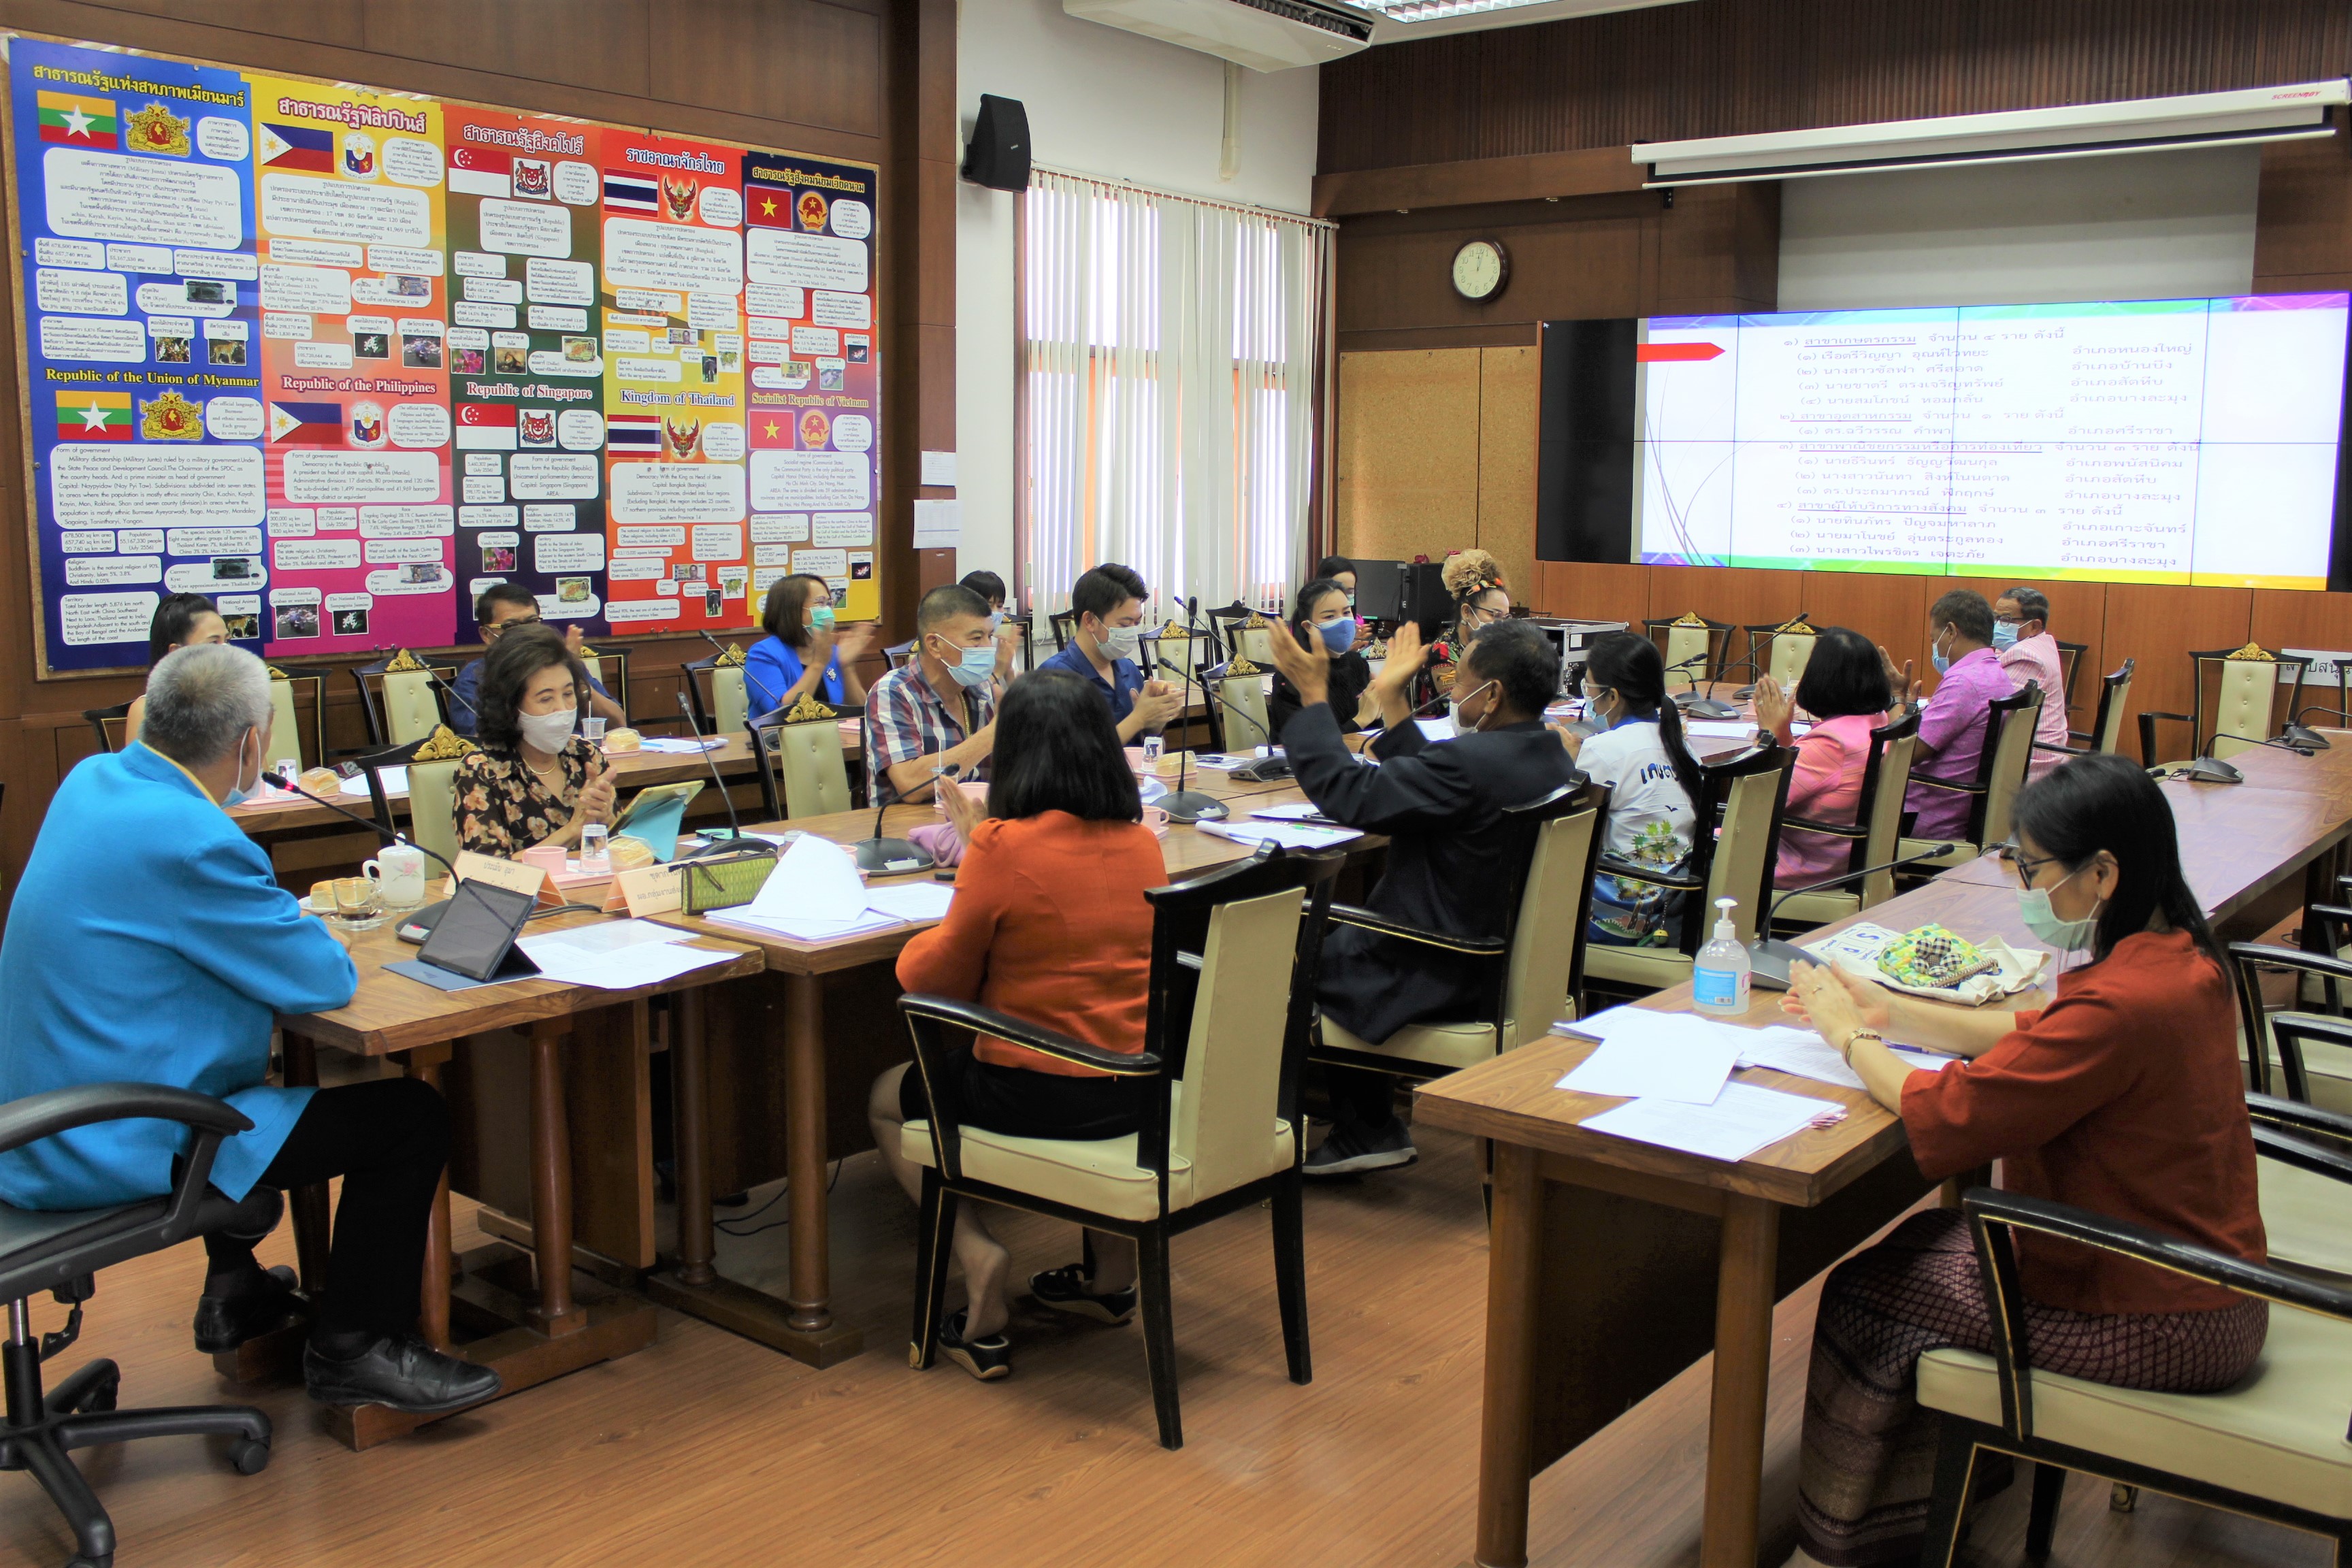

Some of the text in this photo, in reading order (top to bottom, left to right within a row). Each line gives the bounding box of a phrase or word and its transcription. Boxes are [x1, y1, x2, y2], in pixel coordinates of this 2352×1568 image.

[33, 65, 245, 108] สาธารณรัฐแห่งสหภาพเมียนมาร์
[278, 97, 426, 134] สาธารณรัฐฟิลิปปินส์
[463, 125, 583, 155] สาธารณรัฐสิงคโปร์
[625, 147, 725, 175] ราชอาณาจักรไทย
[753, 166, 865, 193] สาธารณรัฐสังคมนิยมเวียดนาม
[1804, 336, 1916, 344] สาขาเกษตรกรรม
[1929, 333, 1977, 342] จำนวน
[2034, 327, 2065, 339] ดังนี้
[2073, 343, 2192, 355] อำเภอหนองใหญ่
[2072, 360, 2172, 370] อำเภอบ้านบึง
[46, 368, 259, 388] Republic of the Union of Myanmar
[282, 376, 436, 395] Republic of the Philippines
[2071, 376, 2163, 387] อำเภอสัตหีบ
[467, 382, 593, 402] Republic of Singapore
[620, 389, 736, 406] Kingdom of Thailand
[2070, 393, 2187, 404] อำเภอบางละมุง
[752, 393, 869, 408] Socialist Republic of Vietnam
[1801, 412, 1912, 421] สาขาอุตสาหกรรม
[1923, 410, 1970, 420] จำนวน
[2035, 406, 2065, 419] ดังนี้
[2068, 425, 2172, 435] อำเภอศรีราชา
[2065, 474, 2157, 484] อำเภอสัตหีบ
[2065, 491, 2180, 503] อำเภอบางละมุง
[1979, 504, 2028, 513] จำนวน
[2061, 538, 2166, 549] อำเภอศรีราชา
[2061, 553, 2176, 568] อำเภอบางละมุง
